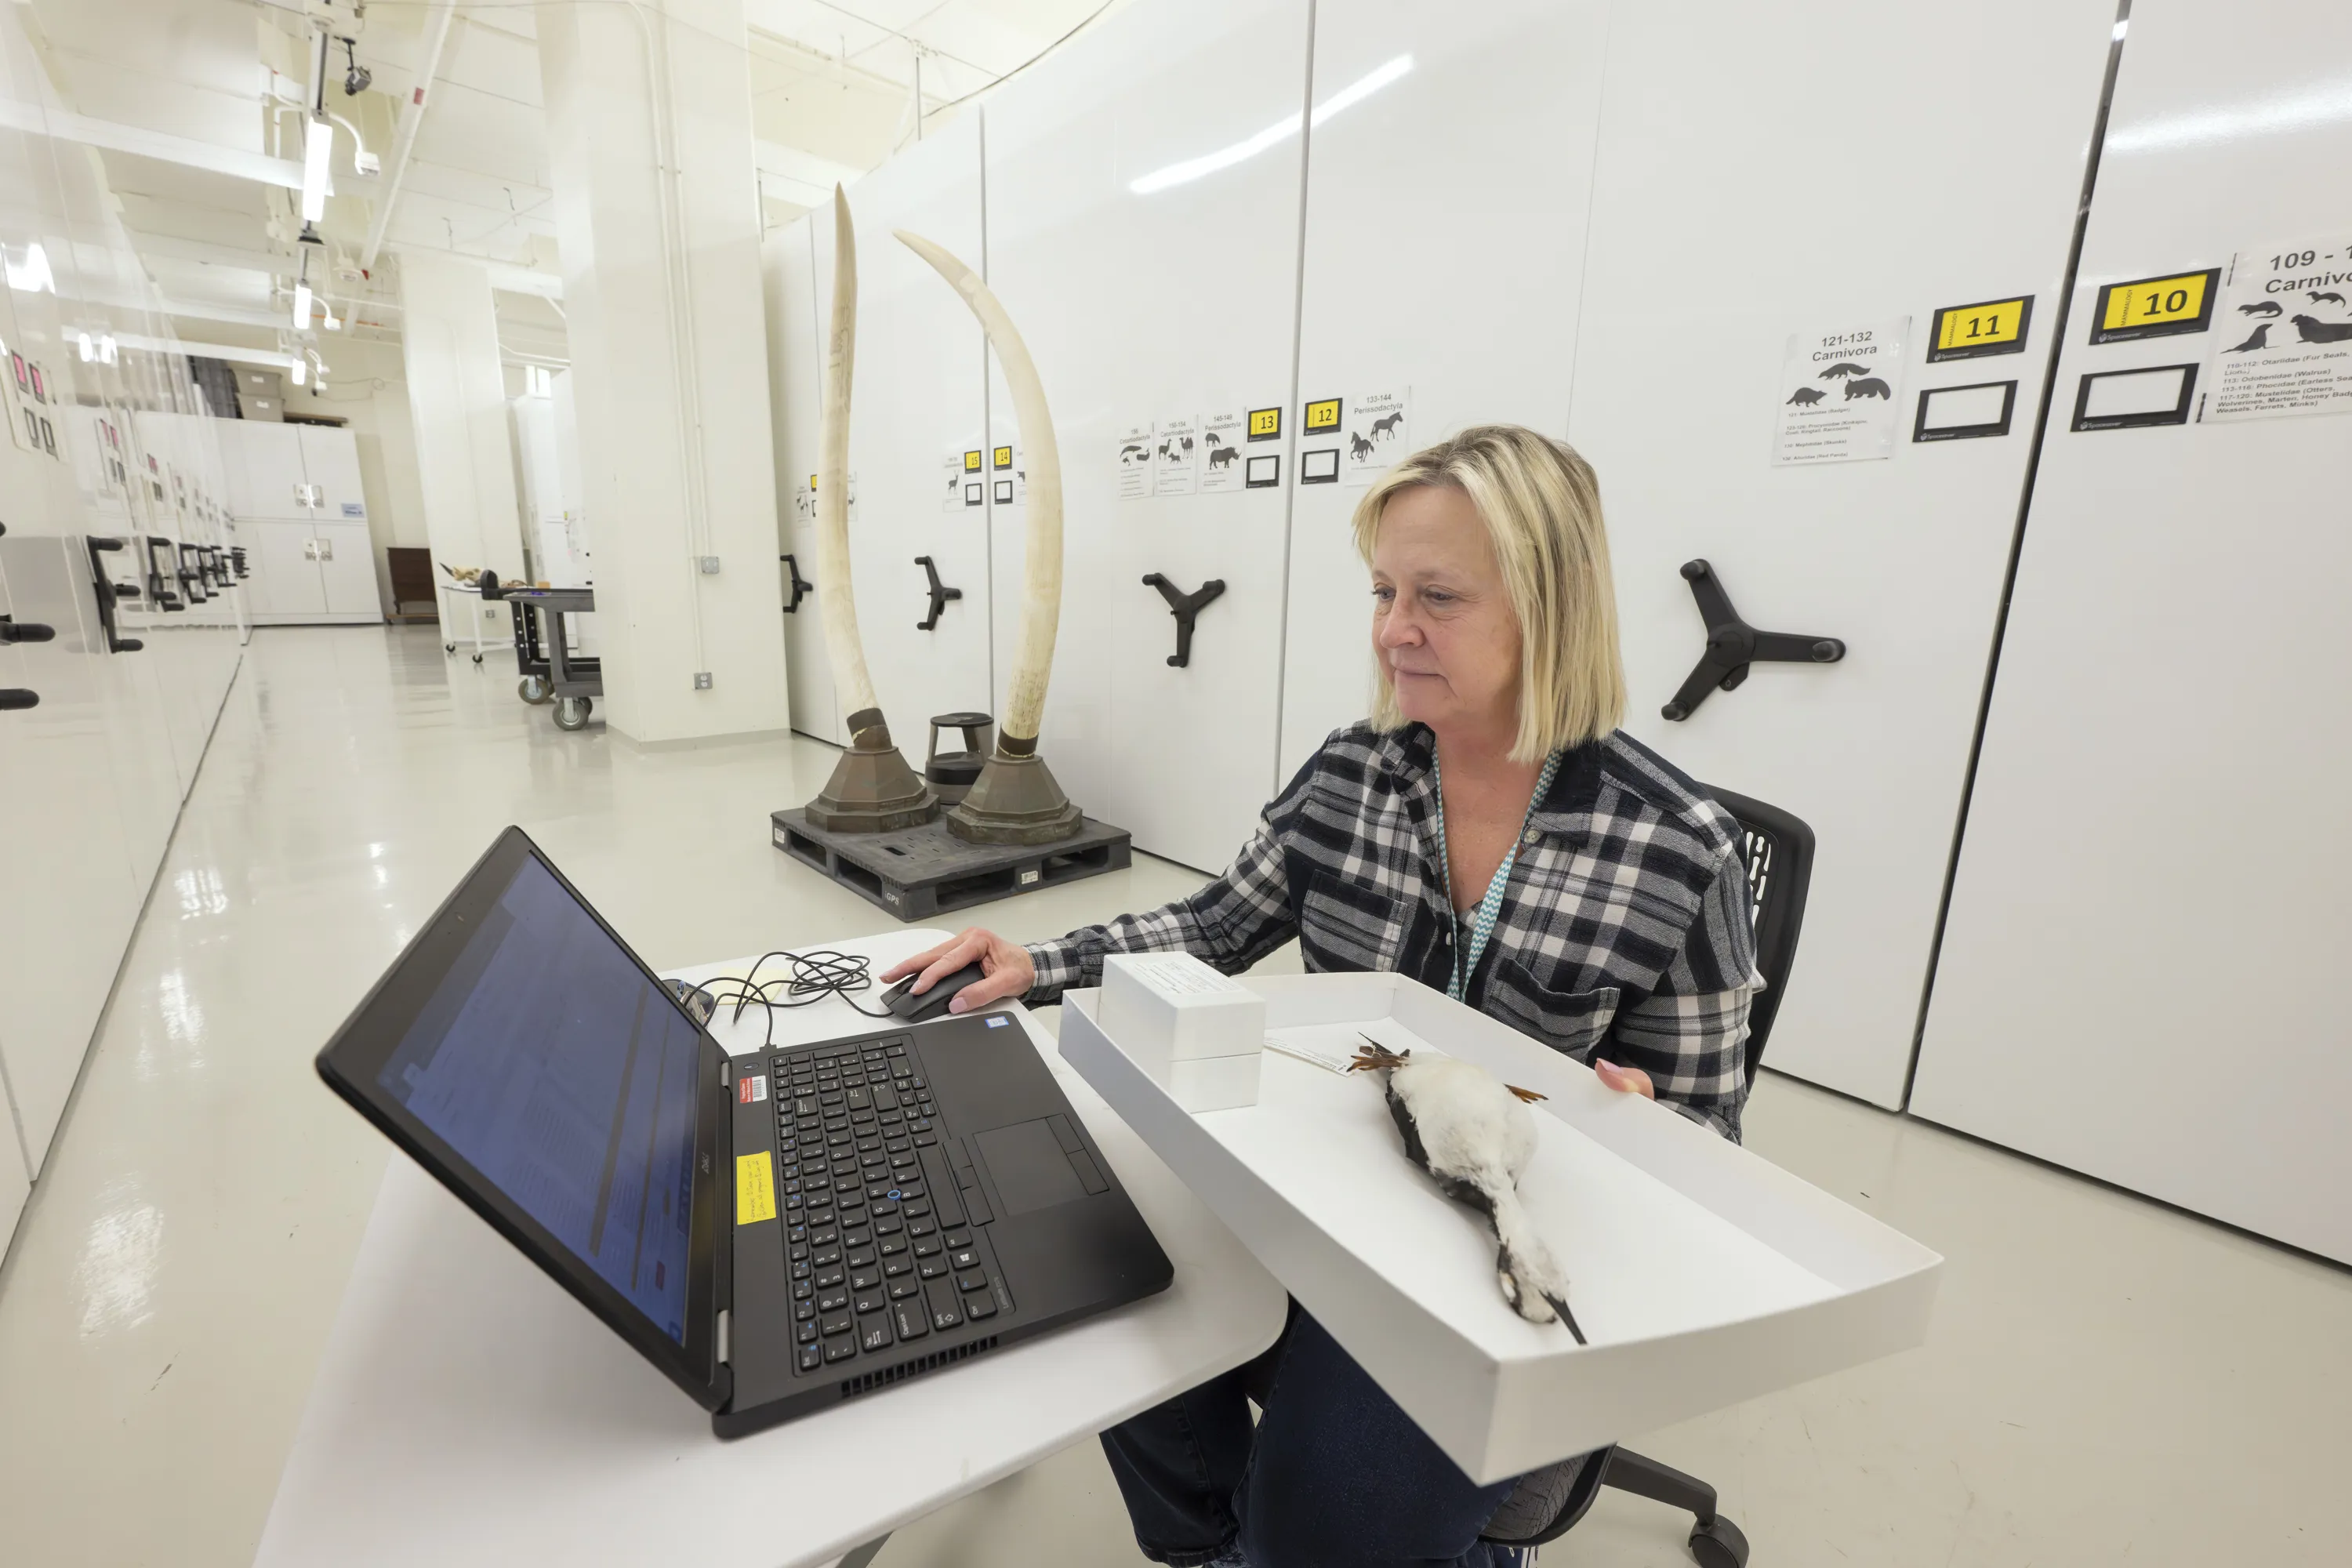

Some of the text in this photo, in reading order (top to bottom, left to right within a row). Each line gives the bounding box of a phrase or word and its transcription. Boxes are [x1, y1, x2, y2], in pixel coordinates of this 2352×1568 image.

[2270, 250, 2316, 271] 109
[2120, 289, 2132, 326] MAMMALOGY
[2143, 289, 2187, 316] 10
[1947, 313, 1958, 347] MAMMALOGY
[1966, 315, 2000, 338] 11
[1821, 331, 1872, 347] 121-132
[1812, 346, 1878, 361] Carnivora
[2262, 357, 2300, 365] Otariidae
[2241, 373, 2292, 383] Odobenidae
[2295, 368, 2331, 378] (Walrus)
[1366, 394, 1392, 404] 133-144
[1354, 402, 1403, 415] Perissodactyla
[1261, 416, 1274, 429] 13
[1319, 409, 1332, 423] 12
[1205, 422, 1241, 431] Perissodactyla
[972, 456, 978, 466] 15
[1000, 452, 1007, 461] 14
[855, 1278, 865, 1287] W
